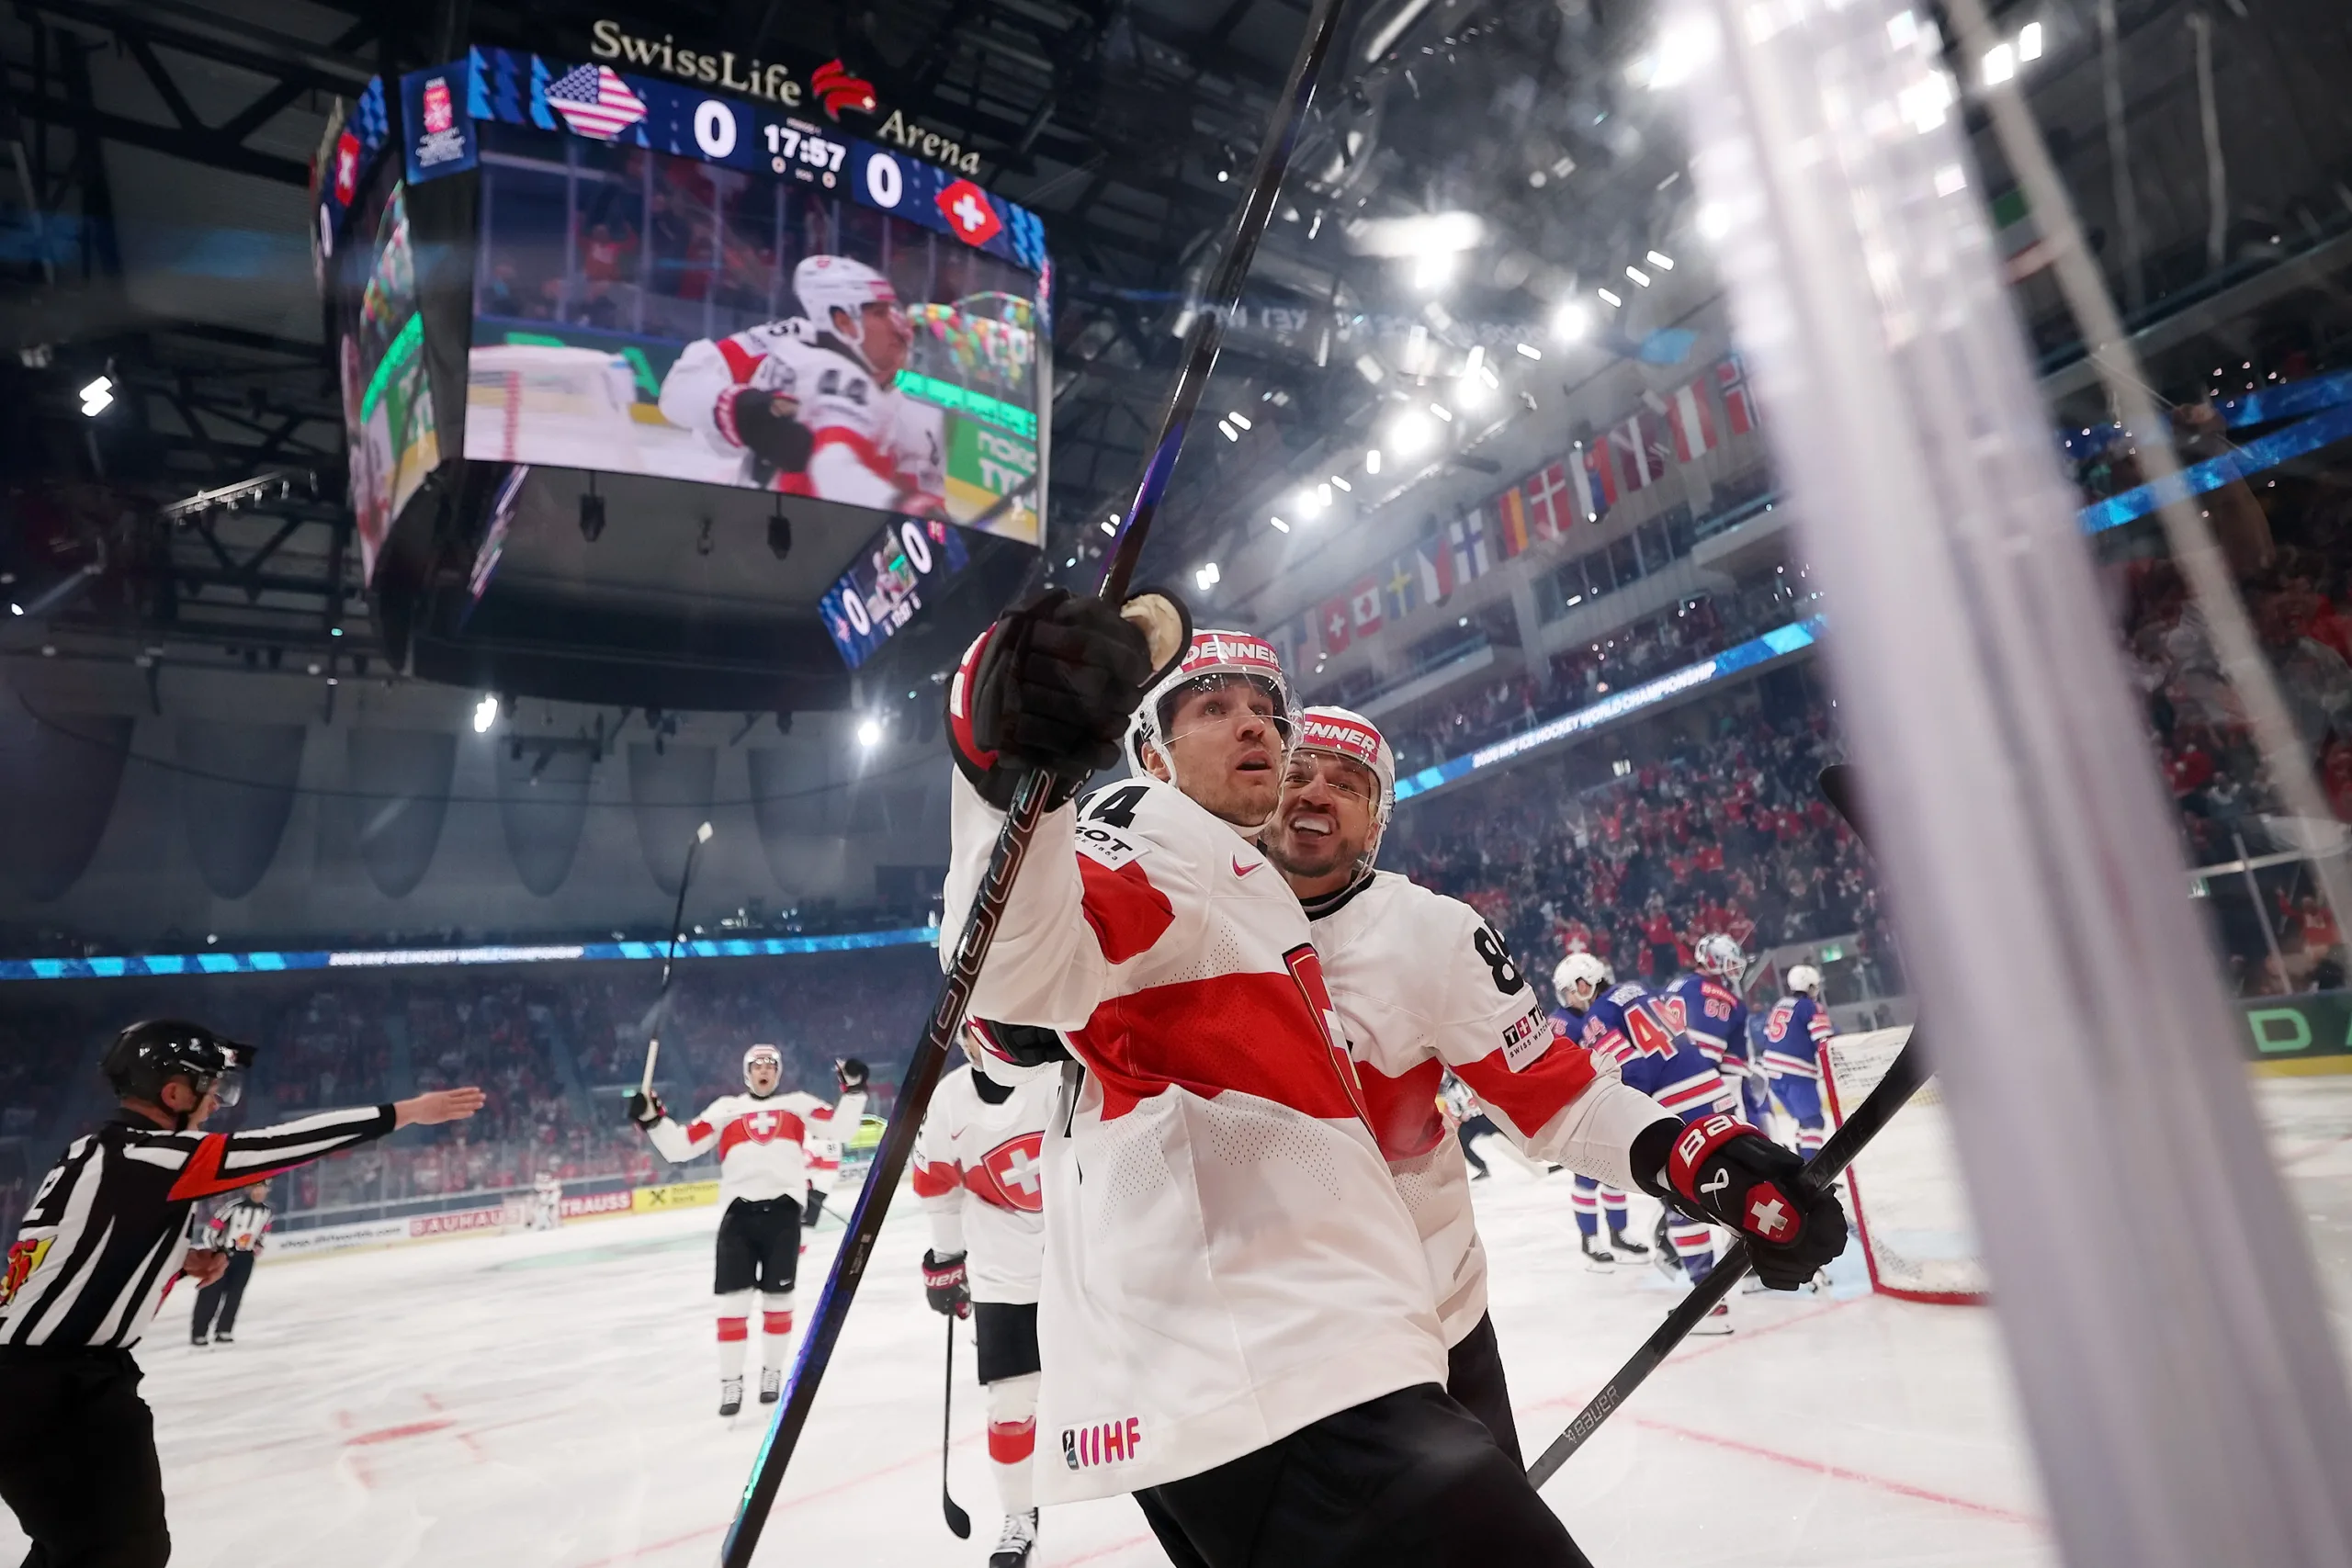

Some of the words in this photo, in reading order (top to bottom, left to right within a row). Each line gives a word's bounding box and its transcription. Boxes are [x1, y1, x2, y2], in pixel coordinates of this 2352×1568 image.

[591, 19, 801, 107] SwissLife
[694, 99, 737, 158] 0
[763, 123, 846, 173] 17:57
[876, 109, 982, 175] Arena
[866, 152, 902, 209] 0
[901, 521, 933, 573] 0
[842, 588, 871, 636] 0
[1182, 640, 1280, 666] DENNER
[1535, 716, 1579, 746] HOCKEY
[1578, 699, 1623, 728] WORLD
[1623, 660, 1717, 710] CHAMPIONSHIP
[1075, 826, 1134, 852] SOT
[1528, 1004, 1546, 1027] TI
[1703, 998, 1731, 1022] 60
[1765, 1008, 1794, 1043] 5
[1510, 1039, 1532, 1058] SWISS
[412, 1206, 524, 1236] BAUHAUS
[560, 1191, 630, 1217] TRAUSS
[924, 1269, 963, 1287] UER
[1080, 1416, 1141, 1467] IIHF
